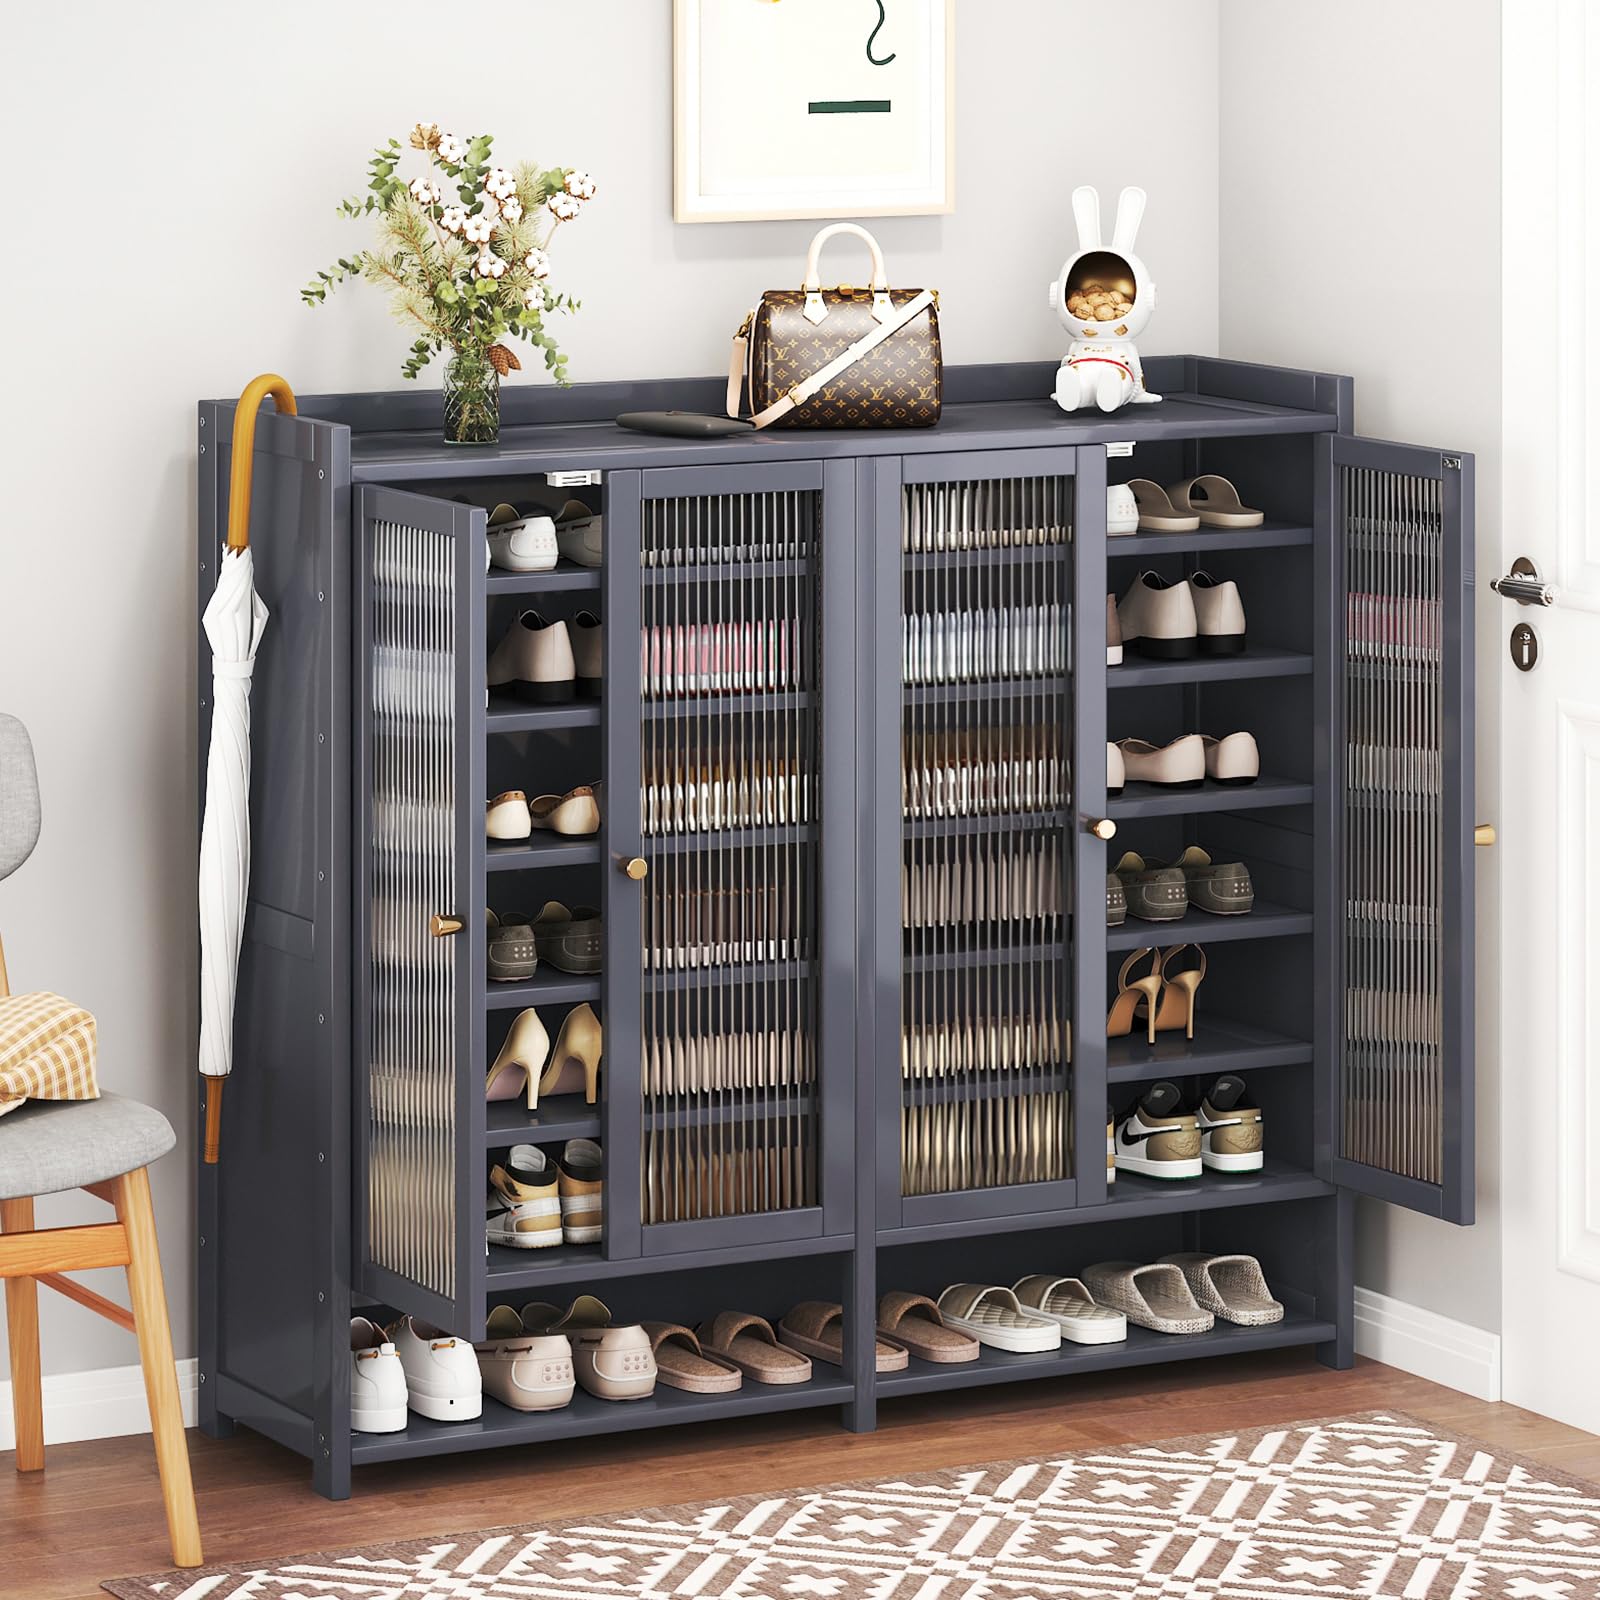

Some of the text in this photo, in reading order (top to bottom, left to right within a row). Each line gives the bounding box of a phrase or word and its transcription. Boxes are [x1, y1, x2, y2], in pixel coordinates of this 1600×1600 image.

[773, 346, 789, 361] LV
[822, 387, 838, 401] LV
[870, 386, 885, 401] LV
[917, 386, 933, 400] LV
